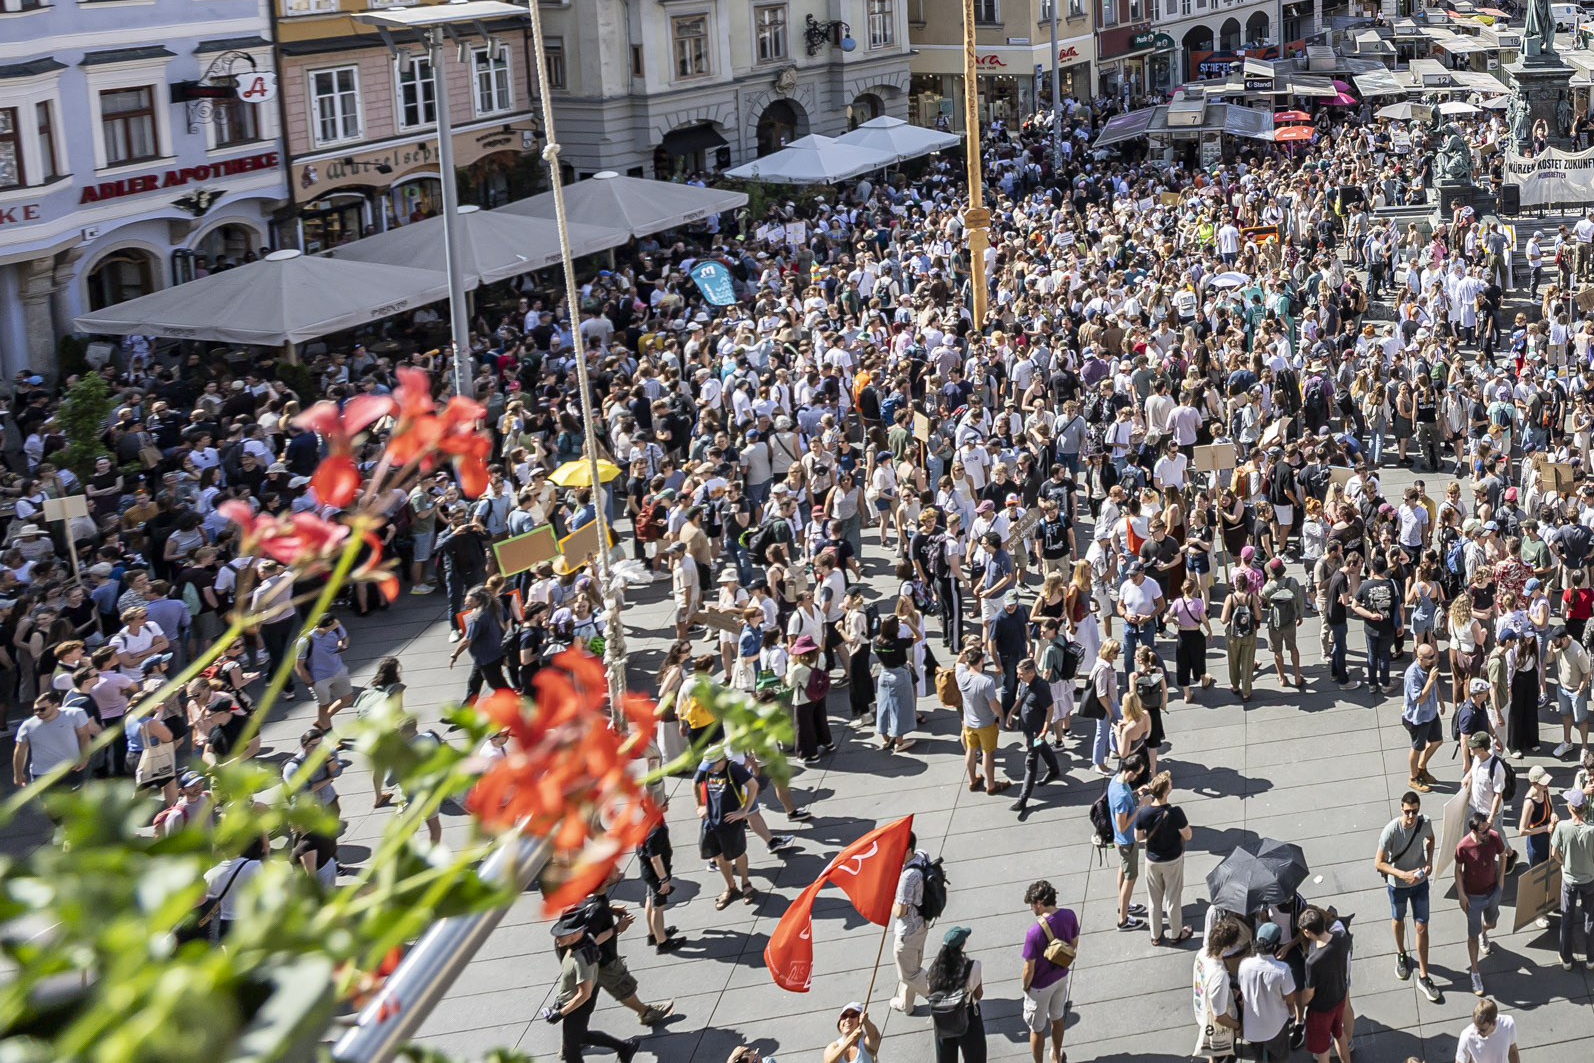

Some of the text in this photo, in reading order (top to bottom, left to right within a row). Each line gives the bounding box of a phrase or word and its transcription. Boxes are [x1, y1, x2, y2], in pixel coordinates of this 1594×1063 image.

[1437, 77, 1447, 85] 12
[1191, 116, 1198, 124] 7
[1508, 161, 1536, 174] KÜRZEN
[1537, 158, 1562, 170] KOSTET
[79, 151, 280, 205] ADLER APOTHEKE
